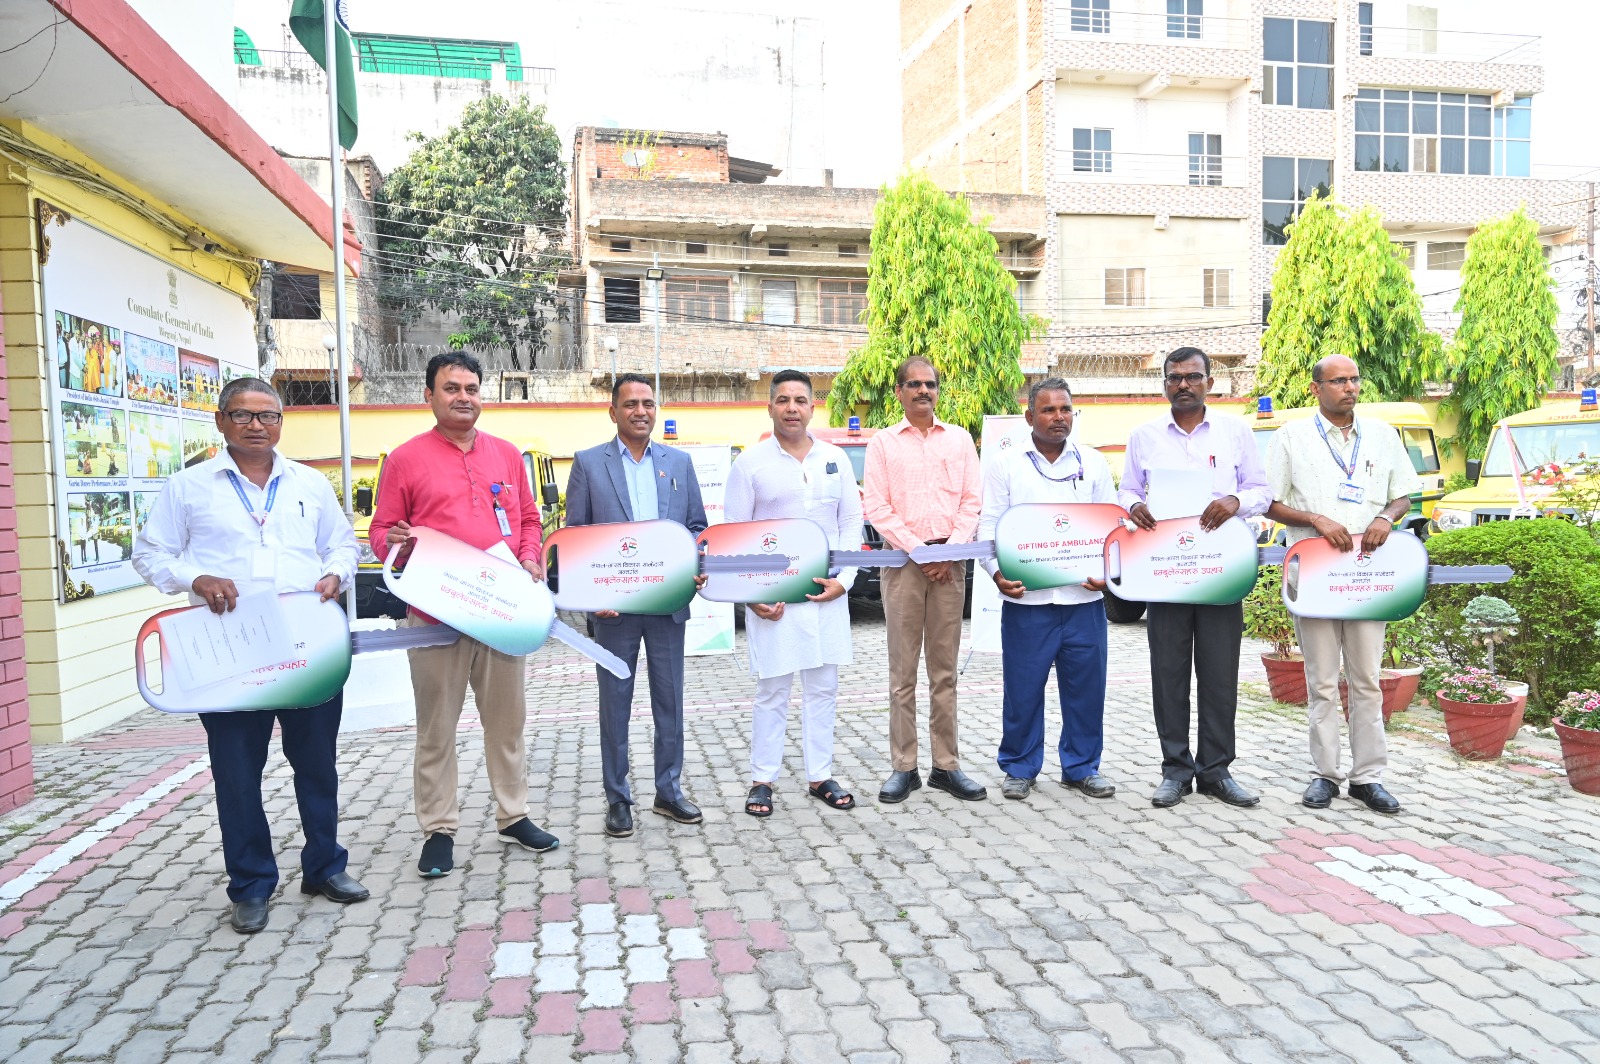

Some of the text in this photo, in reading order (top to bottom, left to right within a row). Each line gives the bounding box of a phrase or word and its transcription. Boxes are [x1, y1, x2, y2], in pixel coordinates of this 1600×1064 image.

[127, 297, 214, 339] Consulate General of India
[179, 333, 192, 346] Nepal
[1017, 541, 1048, 551] GIFTING
[1201, 566, 1224, 575] उपहार
[642, 574, 665, 584] उपहार
[1374, 584, 1394, 592] उपहार
[490, 607, 515, 623] उपहार
